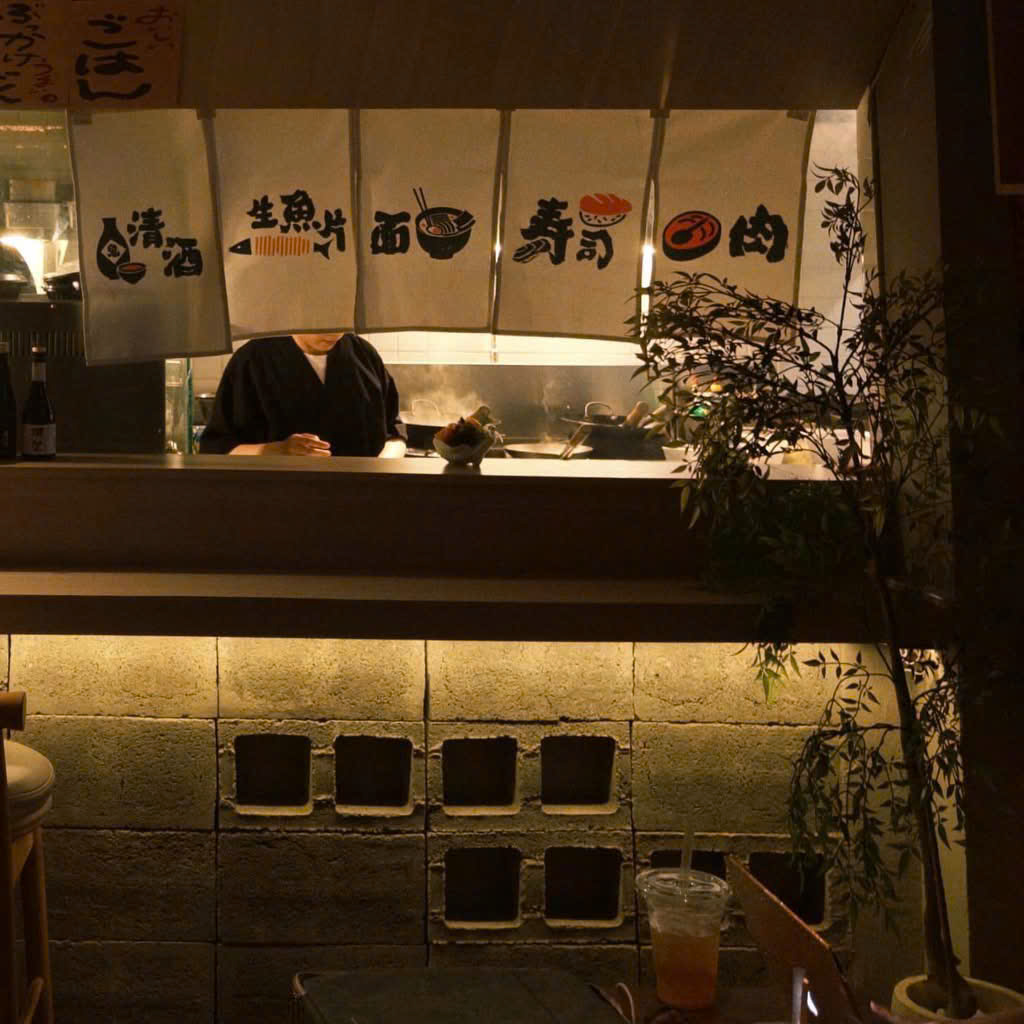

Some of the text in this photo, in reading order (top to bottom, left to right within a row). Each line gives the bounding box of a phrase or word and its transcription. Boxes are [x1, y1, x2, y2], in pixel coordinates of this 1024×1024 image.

[126, 207, 204, 278] 清酒
[247, 189, 348, 253] 生魚片
[729, 204, 789, 263] 肉
